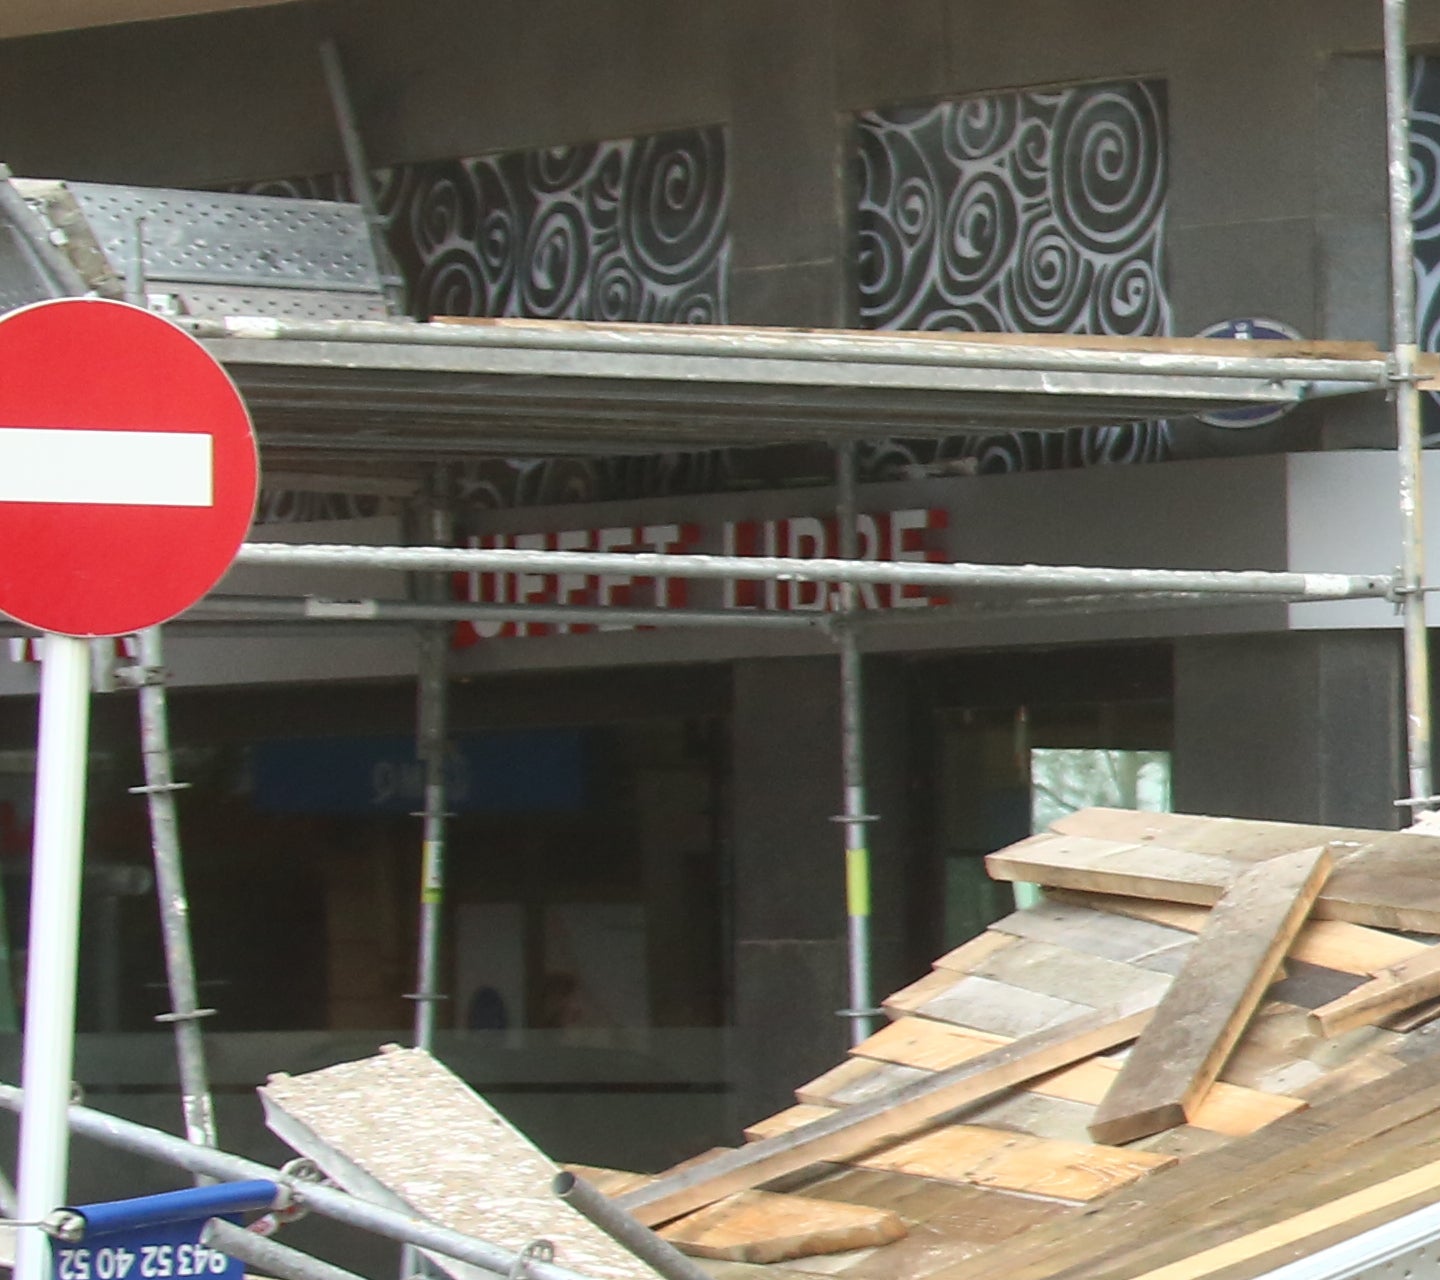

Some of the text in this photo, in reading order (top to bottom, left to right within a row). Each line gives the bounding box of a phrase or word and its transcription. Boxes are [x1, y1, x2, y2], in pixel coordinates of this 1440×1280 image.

[455, 523, 695, 645] UFFET
[96, 1248, 135, 1280] 40
[141, 1245, 172, 1278] 52
